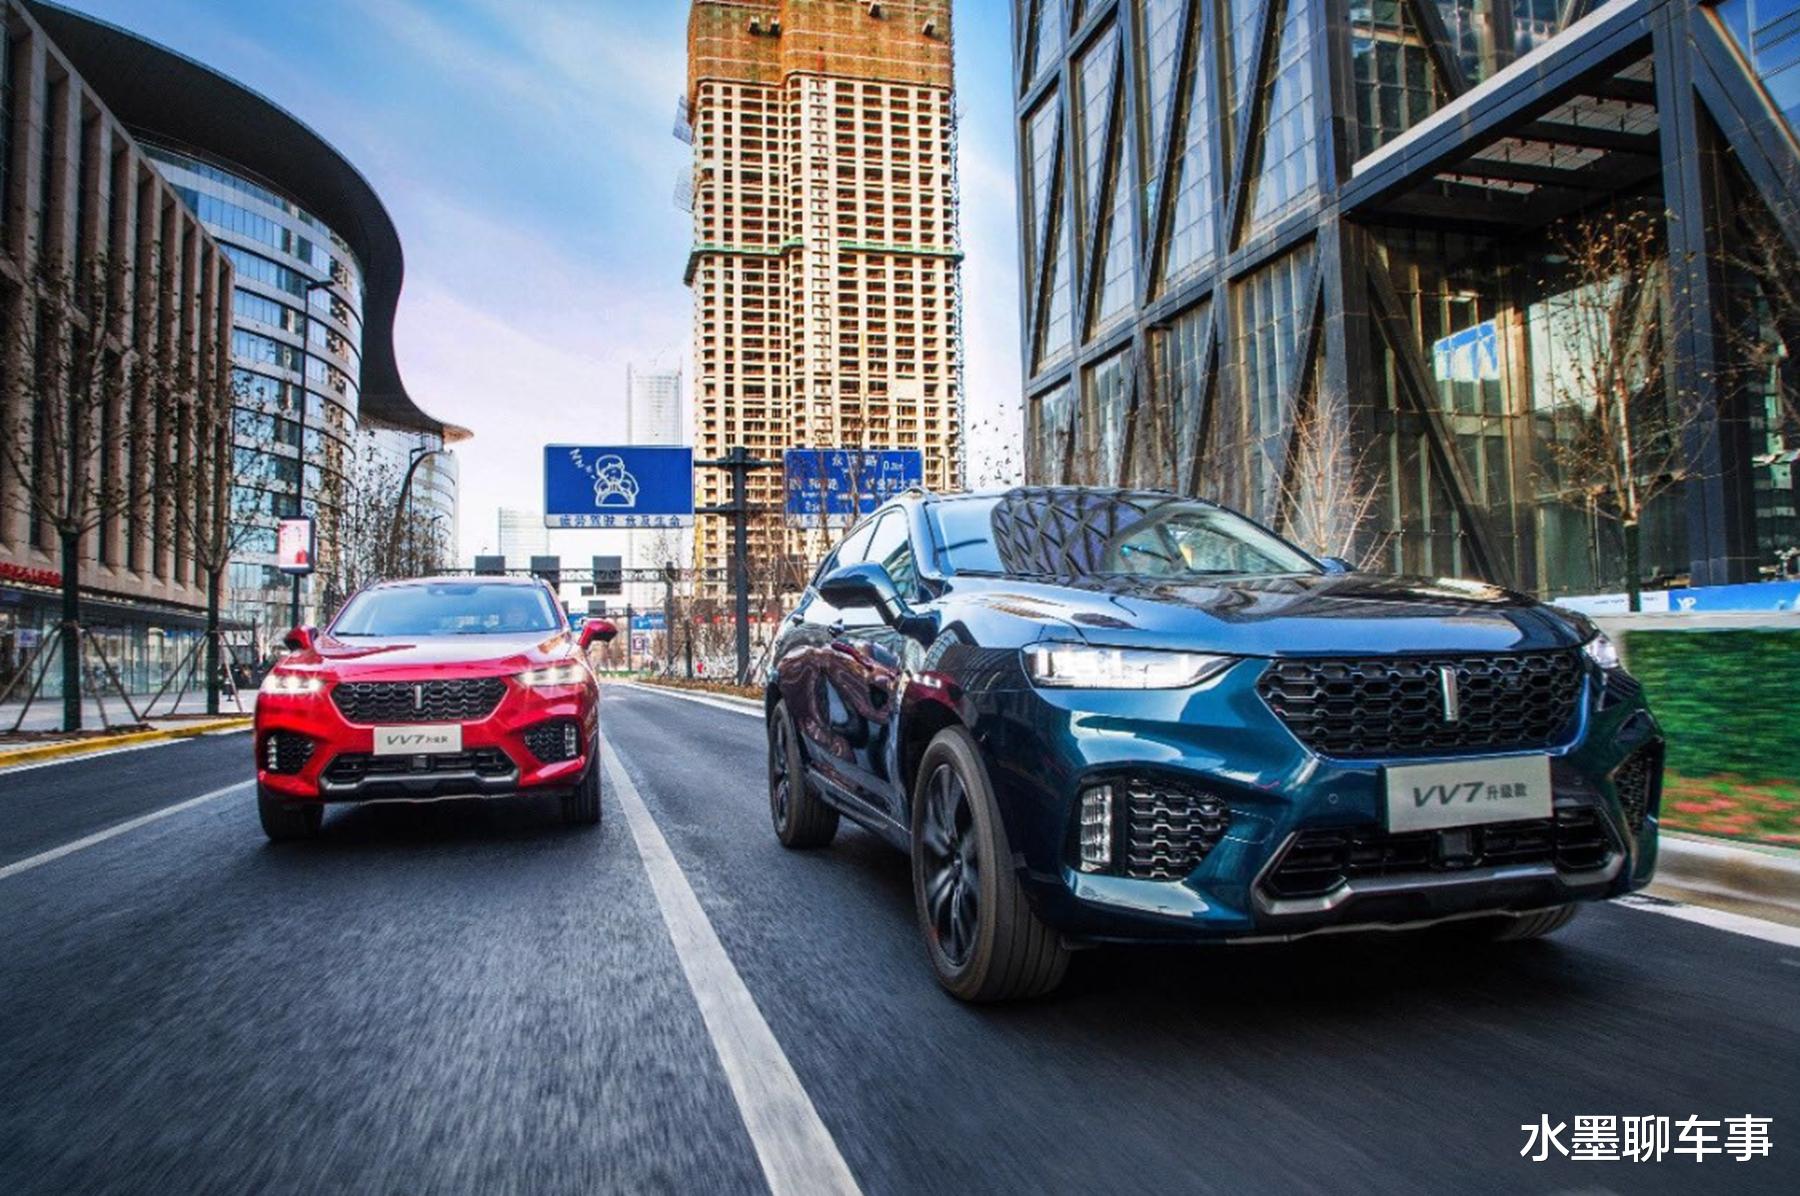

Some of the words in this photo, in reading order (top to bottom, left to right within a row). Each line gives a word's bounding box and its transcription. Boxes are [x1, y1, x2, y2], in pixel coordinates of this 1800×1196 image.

[387, 734, 425, 745] VV7
[1413, 781, 1485, 808] VV7
[1486, 782, 1528, 801] 升级款
